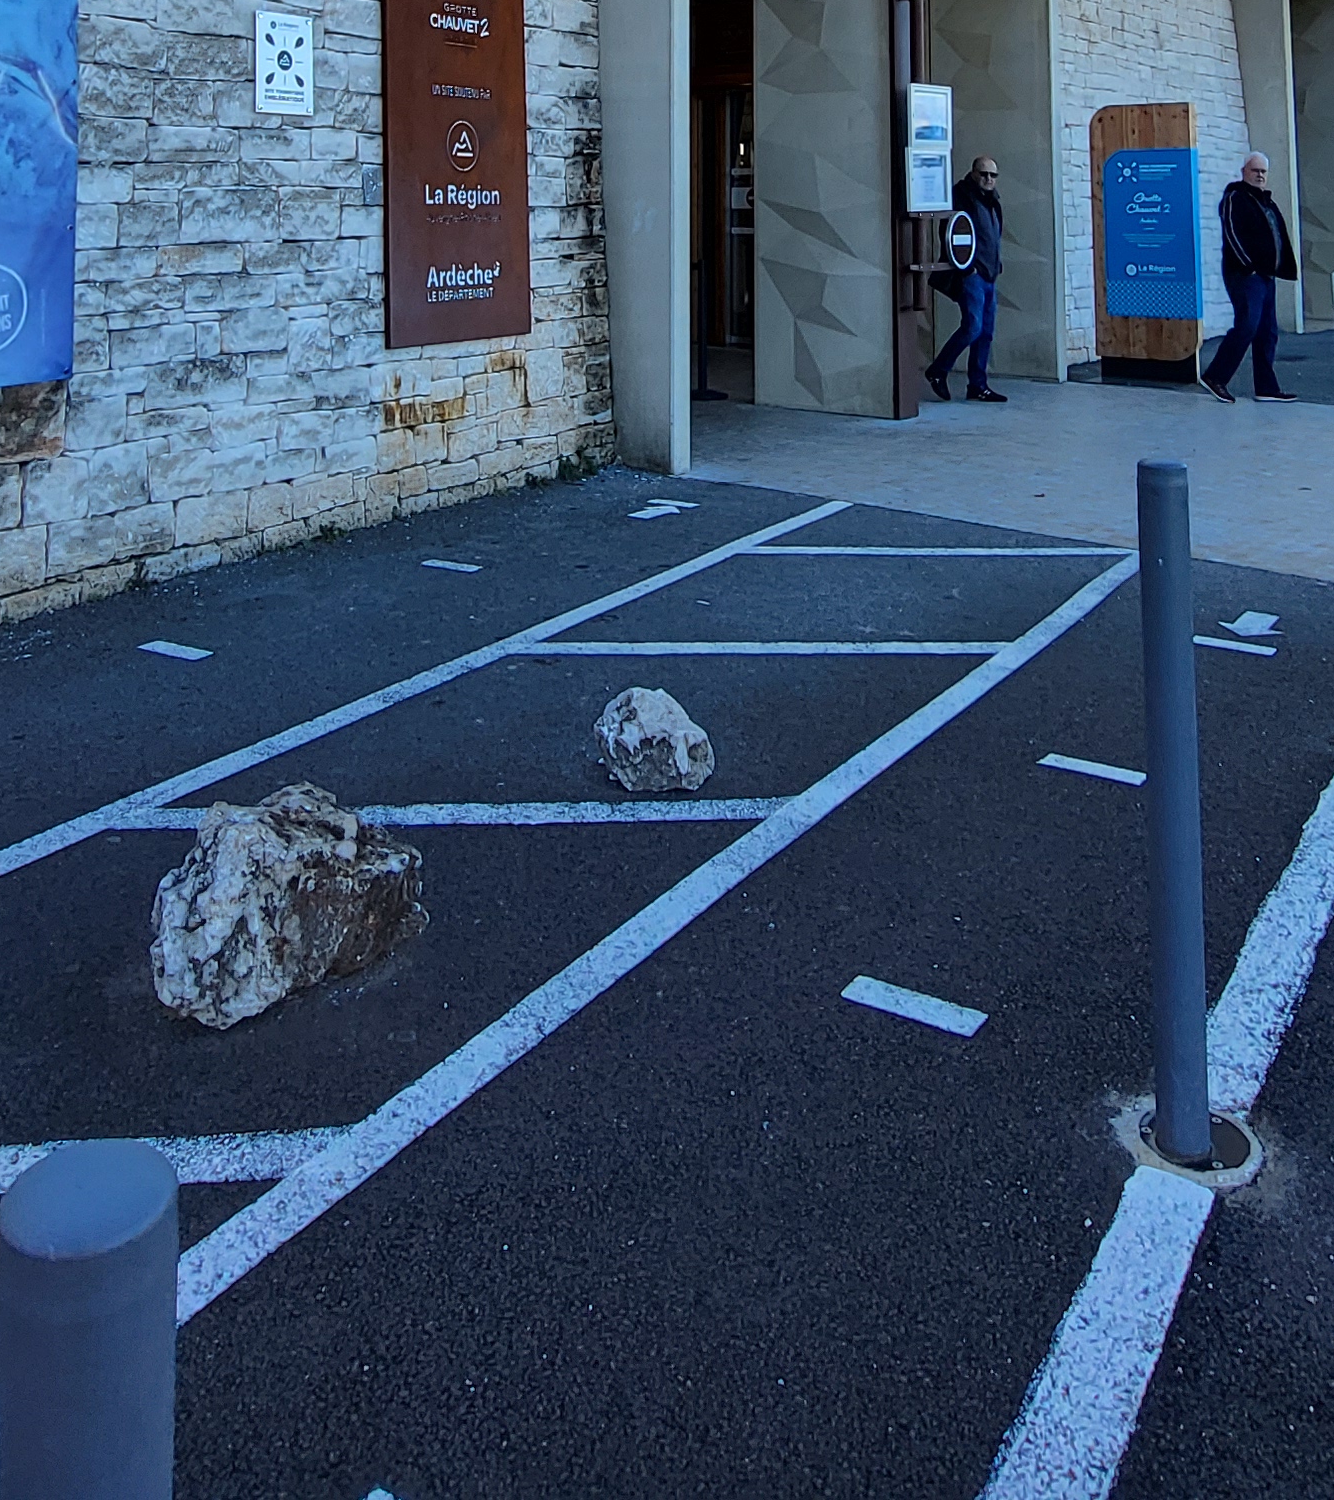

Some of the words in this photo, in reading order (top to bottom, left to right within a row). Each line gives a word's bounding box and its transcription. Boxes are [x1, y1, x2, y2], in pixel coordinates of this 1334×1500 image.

[443, 3, 477, 17] GROTTE
[430, 13, 480, 34] CHAUVET
[480, 18, 490, 37] 2
[425, 184, 444, 205] La
[447, 183, 501, 209] Région
[427, 262, 494, 288] Ardèche
[1138, 264, 1147, 272] La
[427, 290, 437, 302] LE
